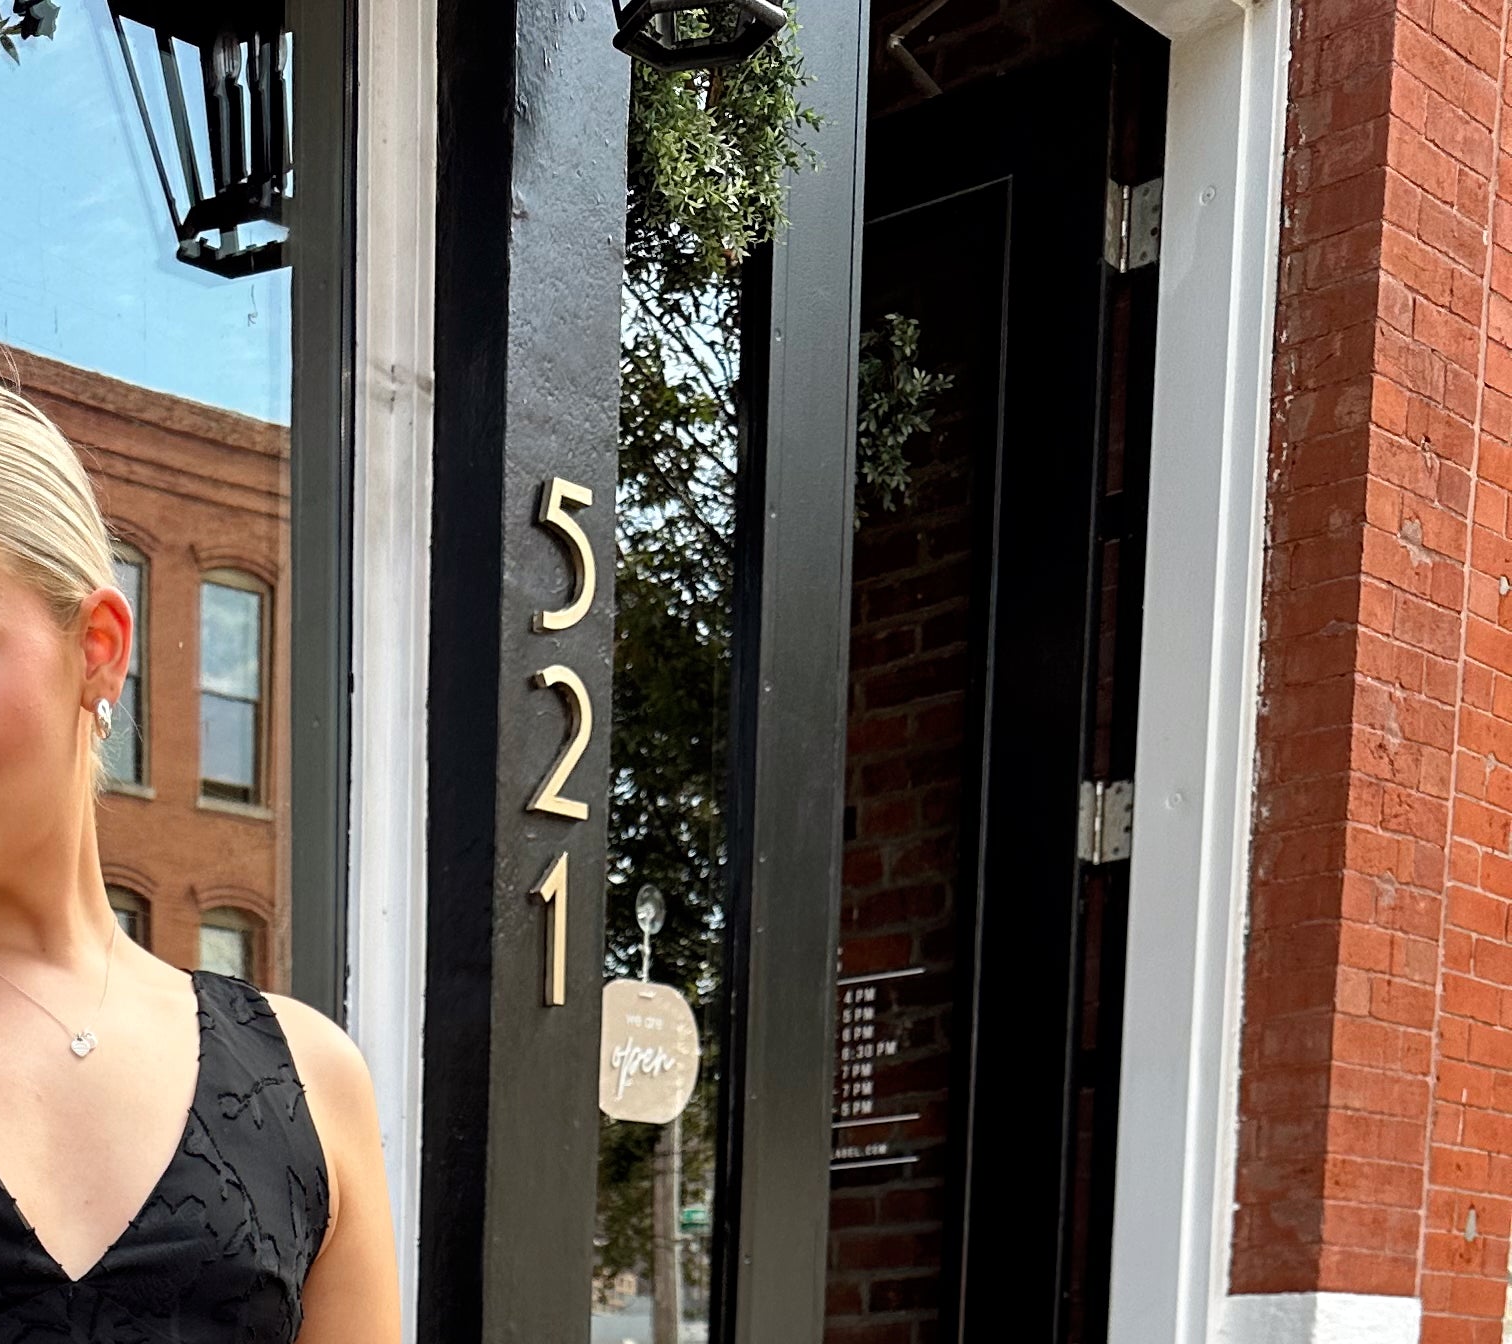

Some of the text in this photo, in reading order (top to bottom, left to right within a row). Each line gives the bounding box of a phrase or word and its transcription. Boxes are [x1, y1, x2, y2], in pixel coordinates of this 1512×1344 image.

[525, 476, 597, 1008] 521
[855, 986, 876, 1003] PM
[854, 1006, 875, 1022] PM
[853, 1025, 875, 1041] PM
[876, 1041, 897, 1057] PM
[611, 1036, 676, 1101] open
[851, 1062, 873, 1079] PM
[852, 1081, 874, 1097] PM
[852, 1100, 873, 1116] PM
